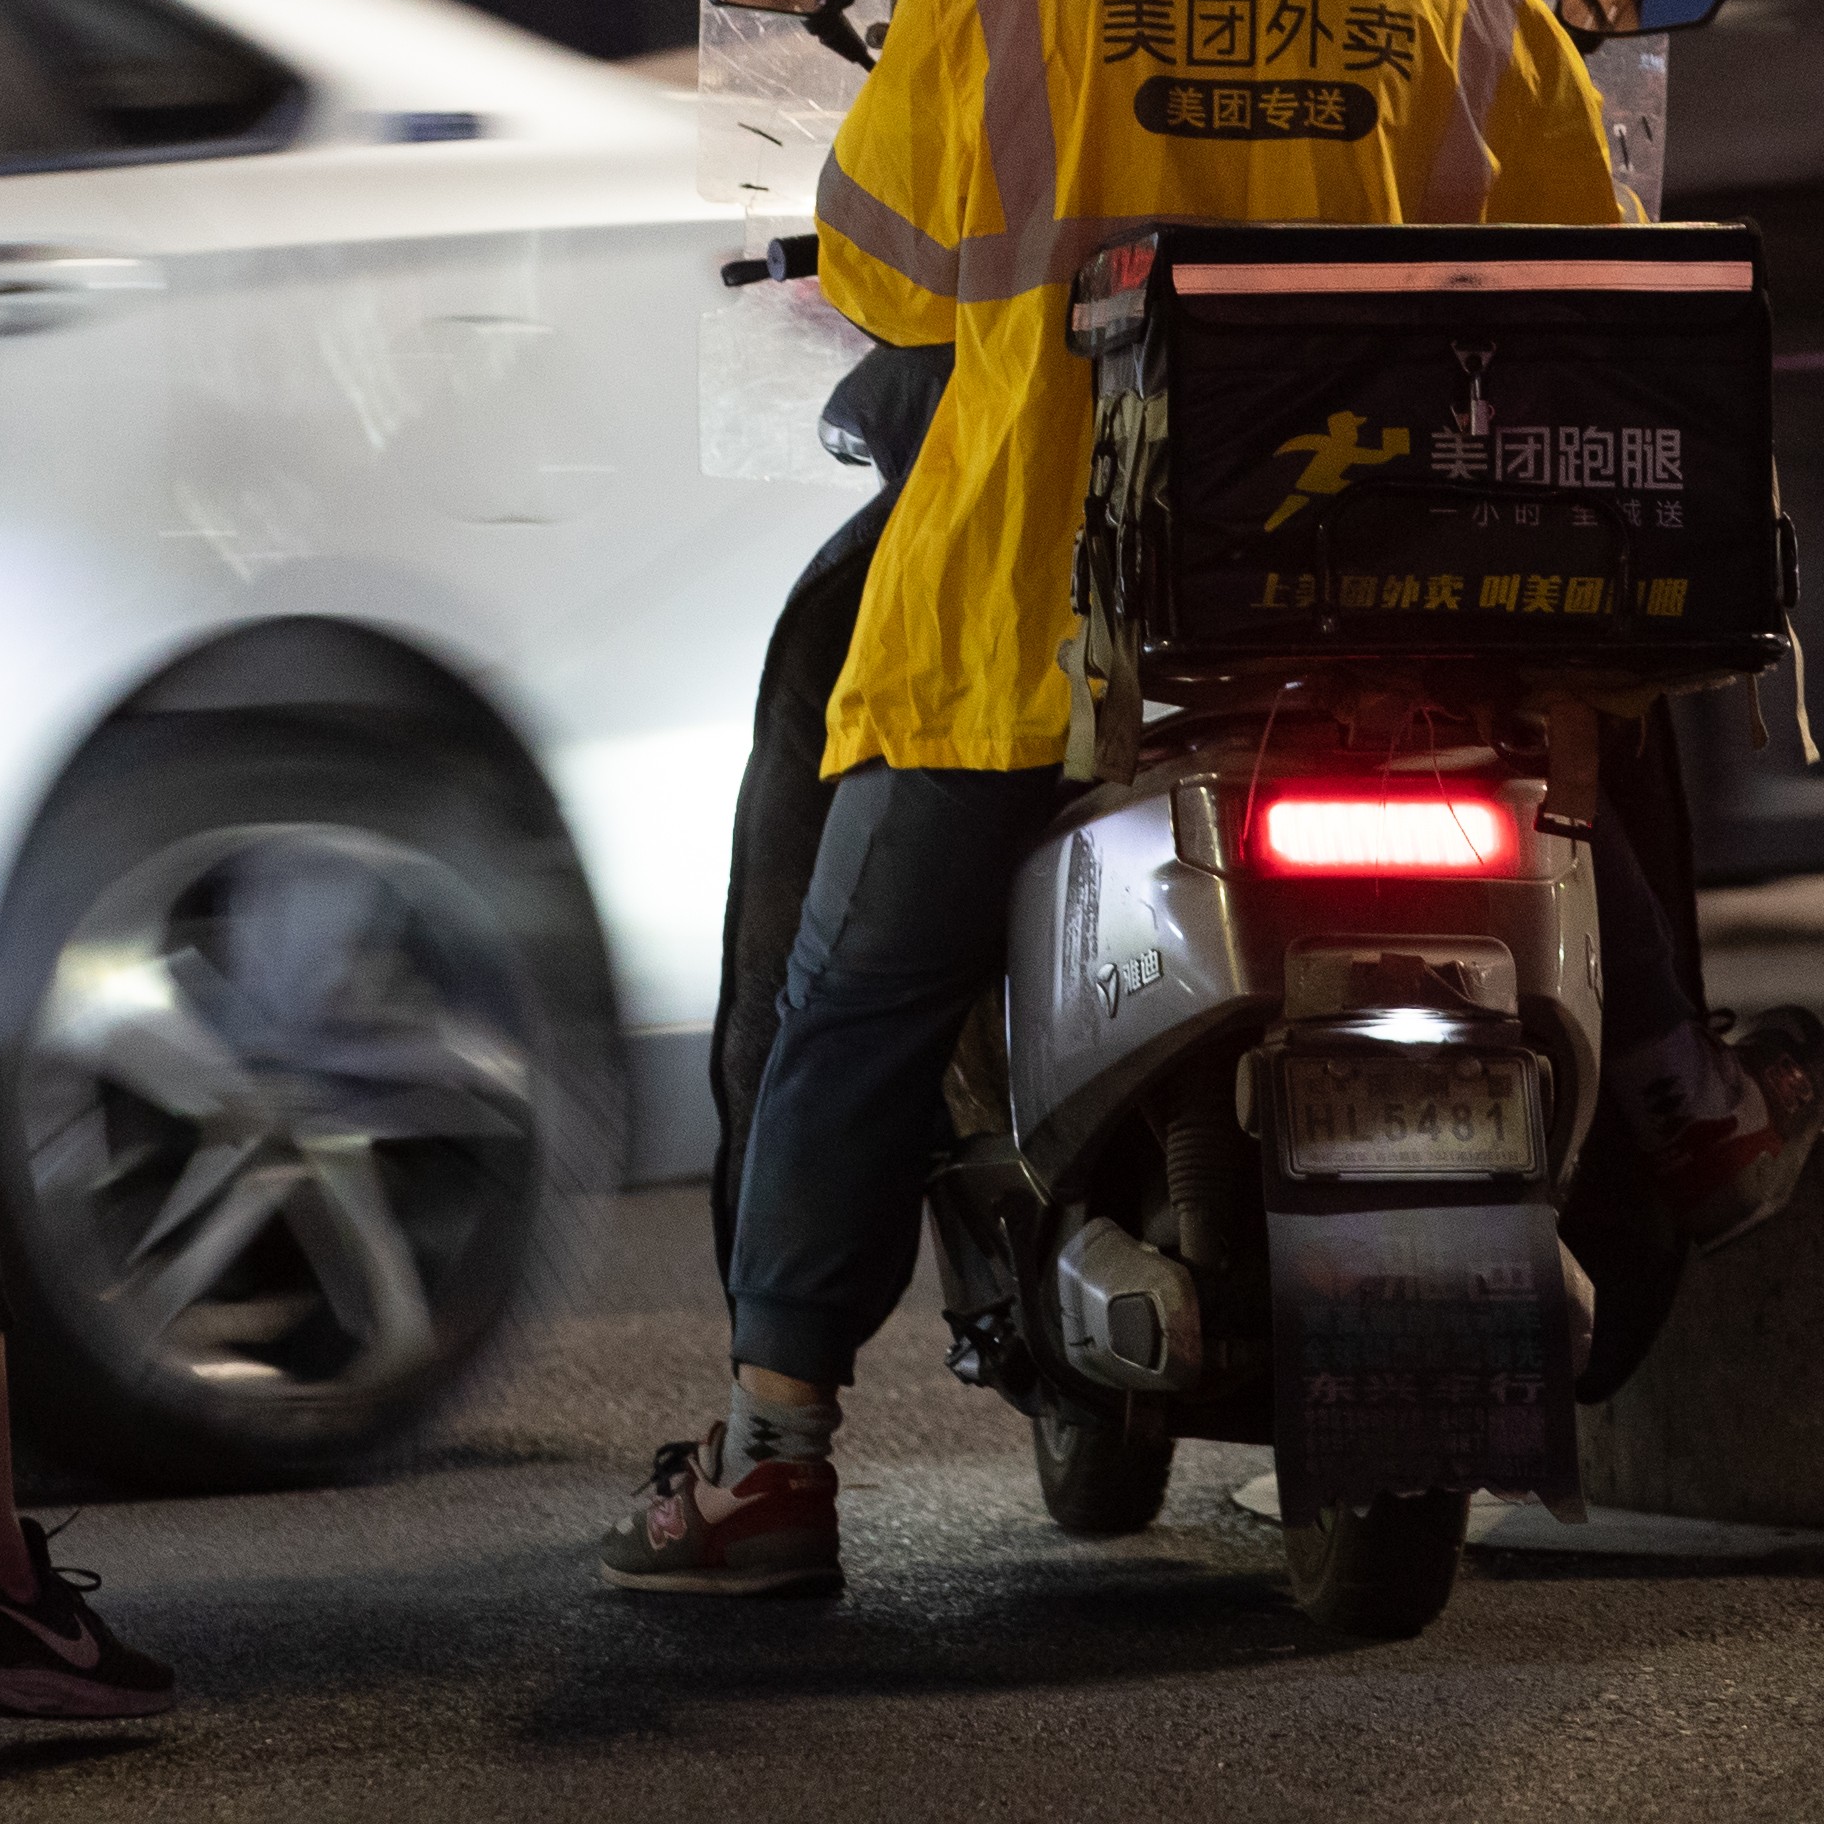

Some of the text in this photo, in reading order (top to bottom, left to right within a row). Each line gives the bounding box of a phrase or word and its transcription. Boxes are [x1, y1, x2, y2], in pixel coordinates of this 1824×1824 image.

[1167, 87, 1347, 131] 美团专送
[1430, 424, 1684, 491] 美团跑腿
